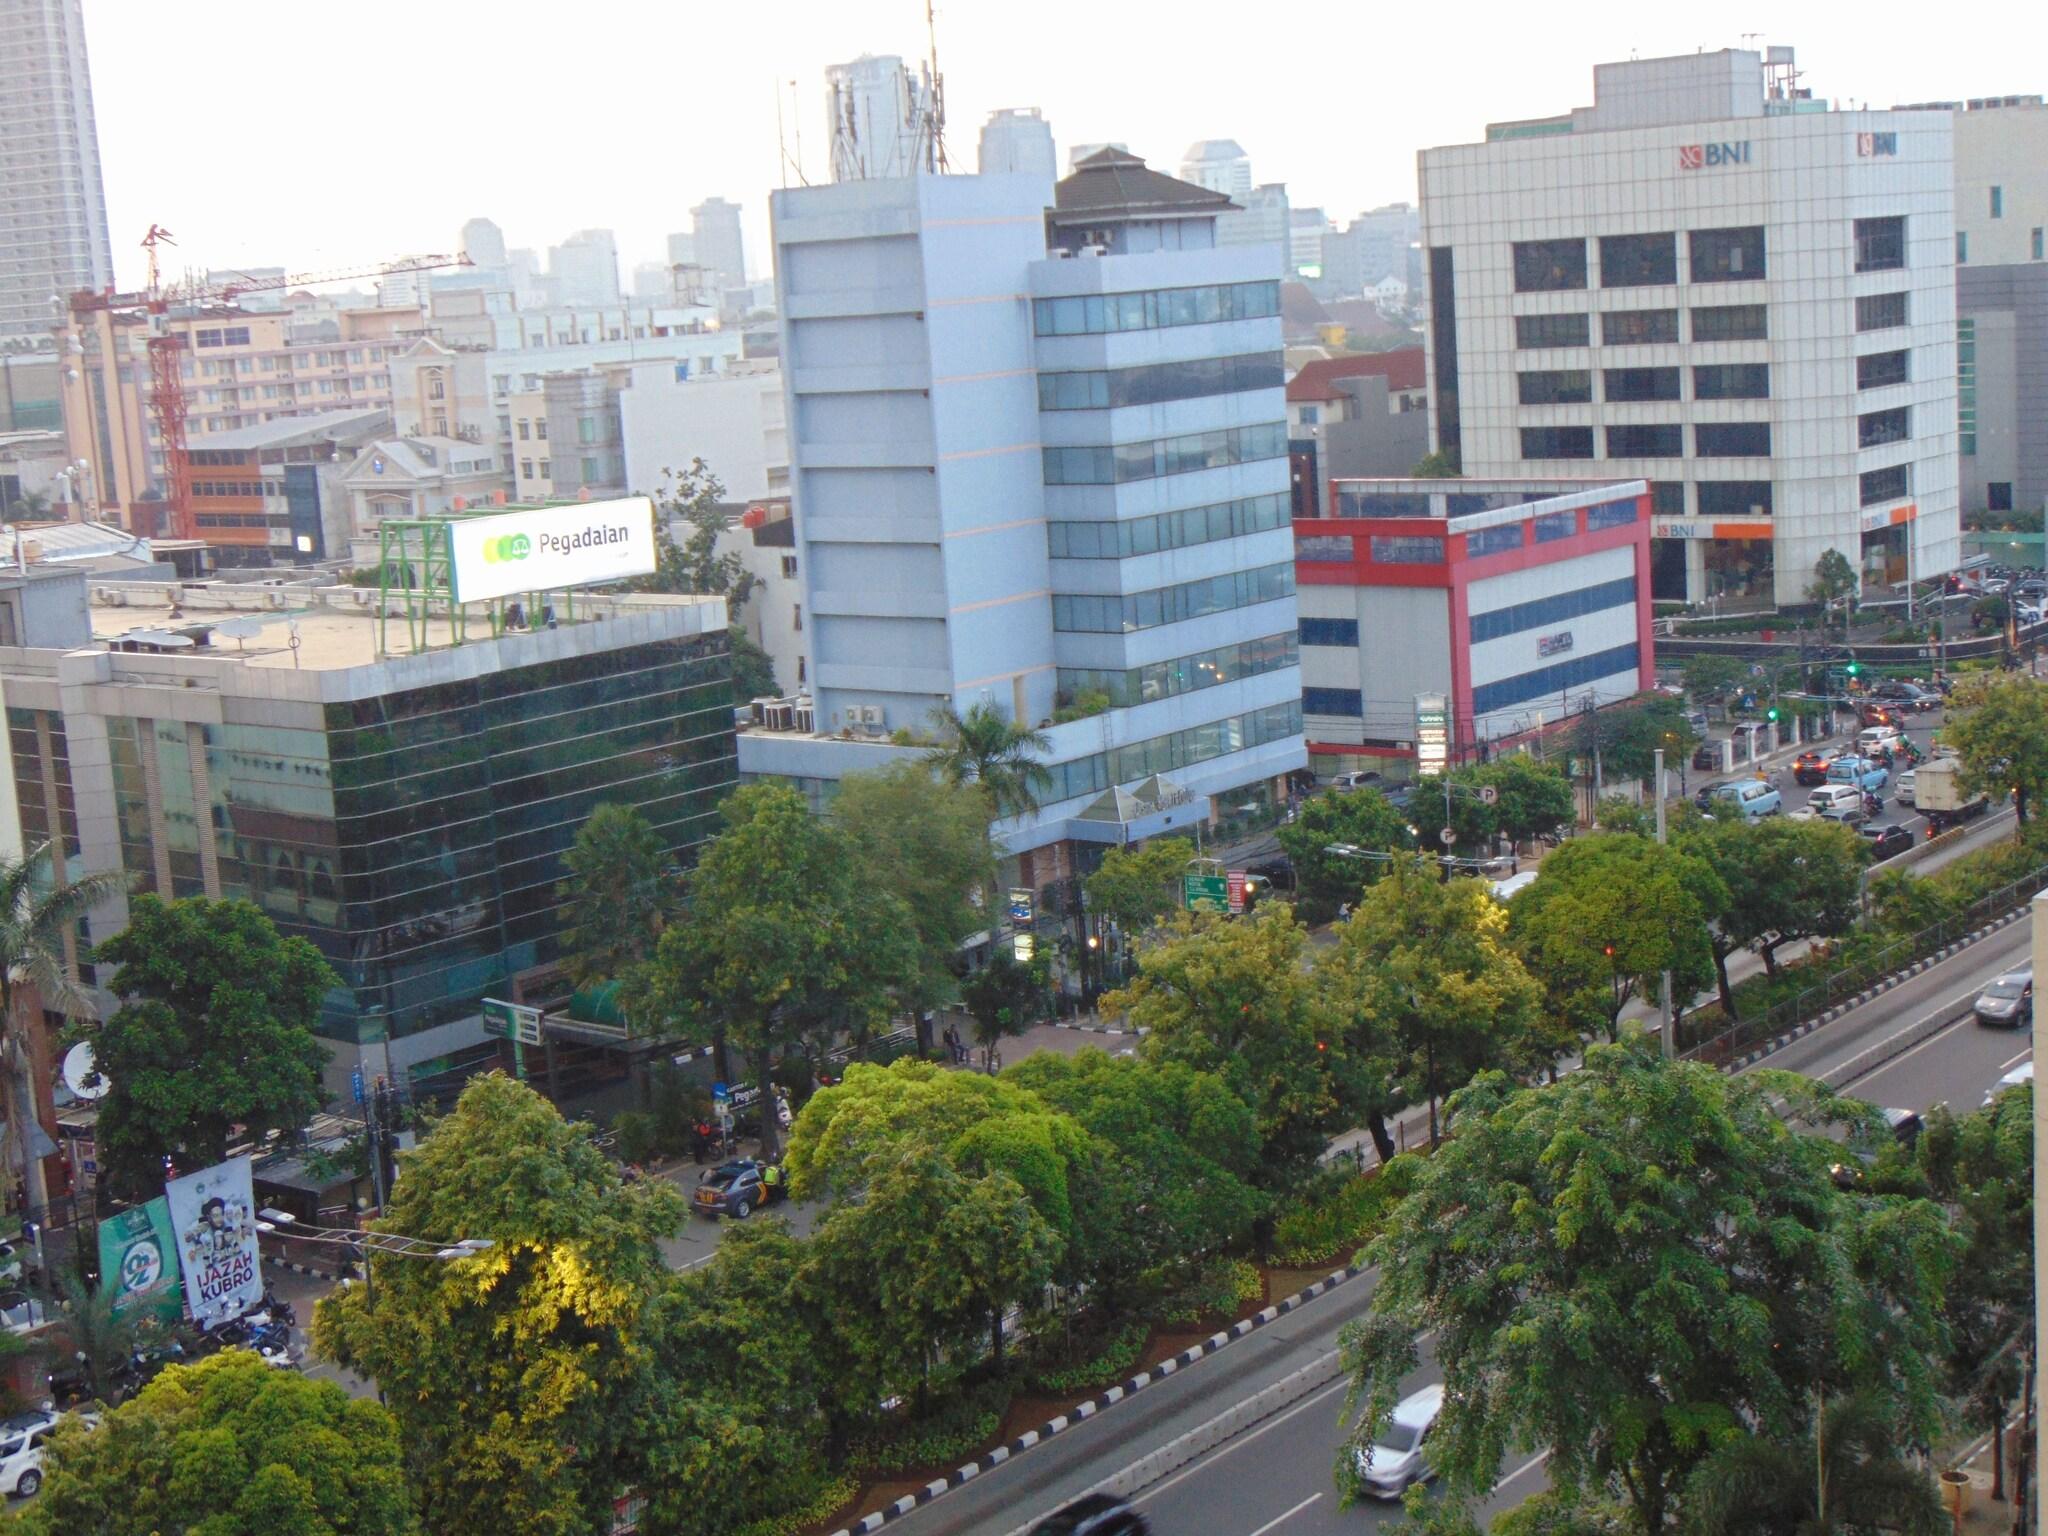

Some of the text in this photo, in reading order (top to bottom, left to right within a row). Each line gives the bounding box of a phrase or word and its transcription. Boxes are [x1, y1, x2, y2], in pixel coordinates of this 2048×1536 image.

[1705, 140, 1750, 166] BNI
[539, 524, 629, 556] Pegadaian
[1670, 525, 1695, 537] BNI
[196, 1252, 253, 1289] IJAZAH
[200, 1267, 254, 1302] KUBRO
